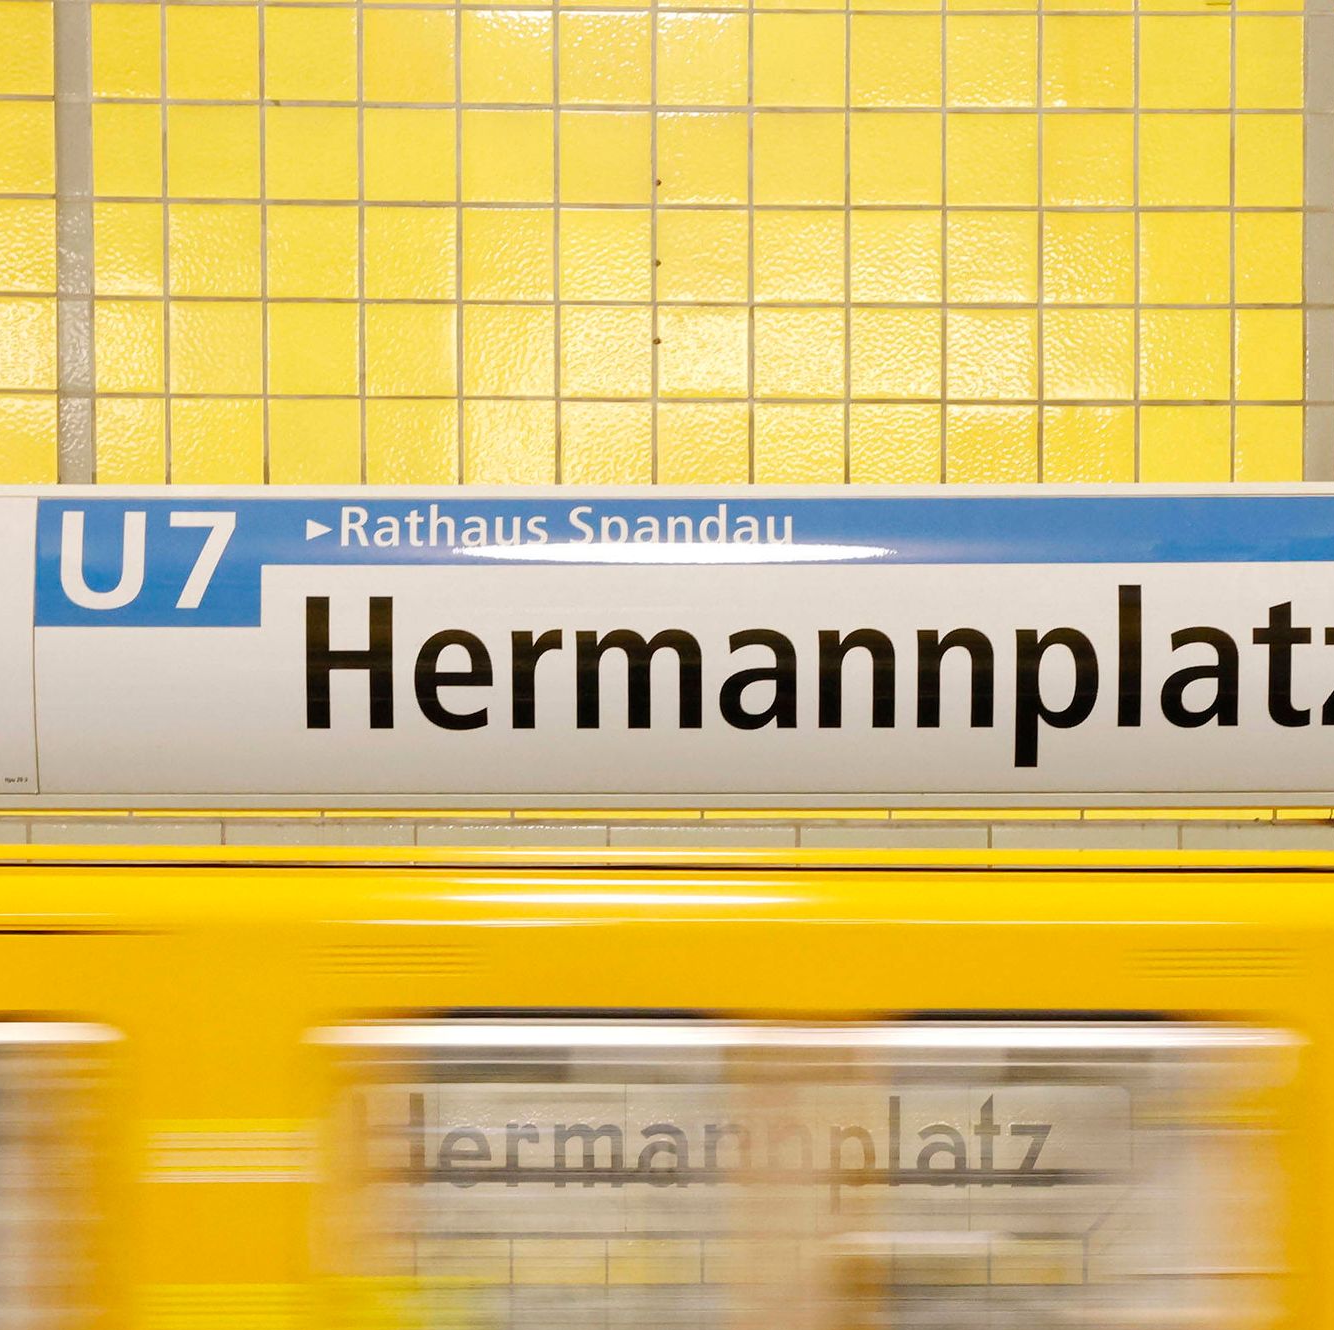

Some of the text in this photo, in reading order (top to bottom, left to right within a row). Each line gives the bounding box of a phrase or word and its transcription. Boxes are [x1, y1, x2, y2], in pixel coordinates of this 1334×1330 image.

[60, 510, 237, 610] U7
[340, 503, 794, 546] Rathaus Spandau
